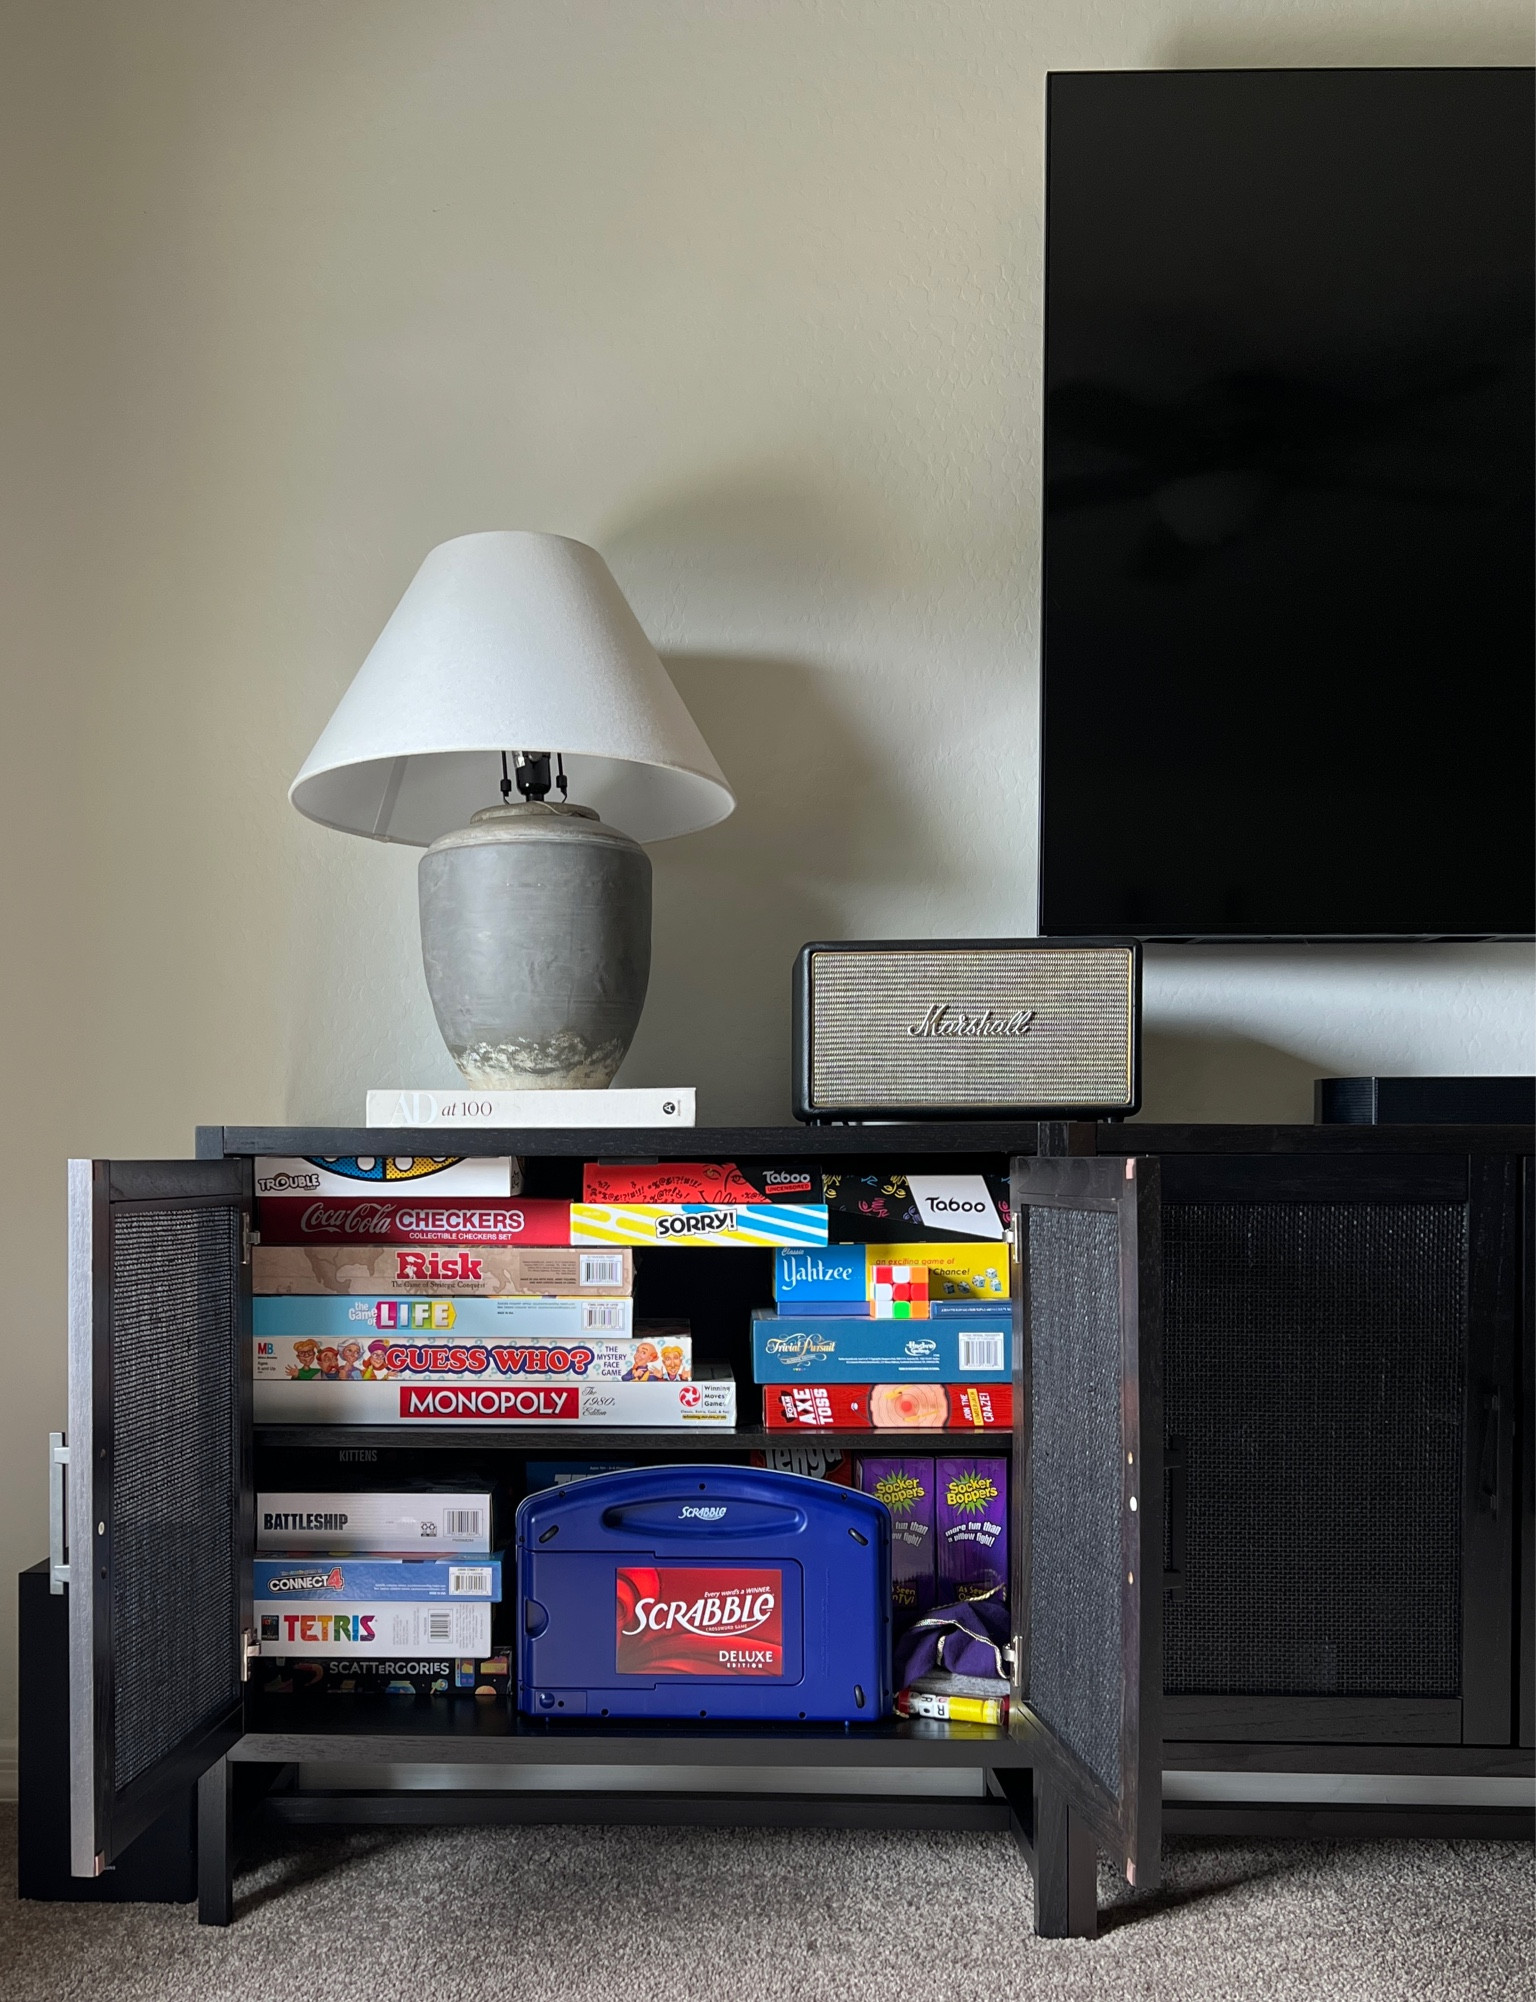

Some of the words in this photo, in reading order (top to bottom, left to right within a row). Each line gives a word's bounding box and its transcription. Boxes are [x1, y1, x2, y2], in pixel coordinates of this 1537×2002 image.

[907, 1004, 1034, 1037] Marshall
[390, 1091, 439, 1125] AD
[441, 1101, 457, 1117] at
[461, 1100, 493, 1117] 100
[258, 1173, 321, 1192] TROUBLE
[763, 1171, 811, 1184] Taboo
[766, 1183, 811, 1194] UNCENSORED
[925, 1196, 985, 1213] Taboo
[301, 1202, 397, 1234] Coca-Cola
[396, 1209, 525, 1232] CHECKERS
[656, 1209, 738, 1239] SORRY!
[396, 1252, 483, 1280] Risk
[781, 1255, 854, 1291] Yahtzee
[933, 1268, 970, 1276] Chance!
[430, 1281, 456, 1290] Strategic
[457, 1281, 486, 1290] Conquest
[355, 1303, 369, 1311] the
[349, 1308, 378, 1321] Game
[380, 1302, 456, 1329] LIFE
[368, 1319, 377, 1327] of
[257, 1342, 274, 1355] MB
[766, 1334, 801, 1354] Trivial
[799, 1333, 836, 1357] Pursuit
[387, 1348, 487, 1371] GUESS
[487, 1349, 592, 1373] WHO?
[583, 1387, 596, 1396] The
[409, 1390, 568, 1415] MONOPOLY
[583, 1397, 616, 1406] 1980's
[781, 1396, 796, 1419] FOAM
[793, 1388, 817, 1425] AXE
[813, 1388, 834, 1425] TOSS
[960, 1394, 970, 1406] THE
[979, 1392, 995, 1422] CRAZE!
[582, 1406, 608, 1417] Edition
[963, 1407, 973, 1421] JOIN
[338, 1450, 378, 1462] KITTENS
[876, 1479, 919, 1493] Socker
[949, 1479, 993, 1494] Socker
[946, 1487, 998, 1505] Boppers
[263, 1513, 348, 1531] BATTLESHIP
[895, 1521, 908, 1530] fun
[909, 1521, 928, 1536] than
[945, 1524, 967, 1537] more
[968, 1521, 982, 1531] fun
[982, 1521, 1002, 1536] than
[903, 1532, 922, 1547] fight!
[975, 1532, 995, 1548] fight!
[269, 1576, 328, 1591] CONNECT
[327, 1568, 344, 1590] 4
[721, 1588, 739, 1596] word's
[746, 1586, 771, 1594] WINNER.
[895, 1585, 916, 1596] Seen
[958, 1585, 968, 1593] As
[899, 1593, 915, 1605] TV!
[283, 1615, 376, 1642] TETRIS
[719, 1651, 773, 1662] DELUXE
[329, 1661, 450, 1675] SCATTERGORIES
